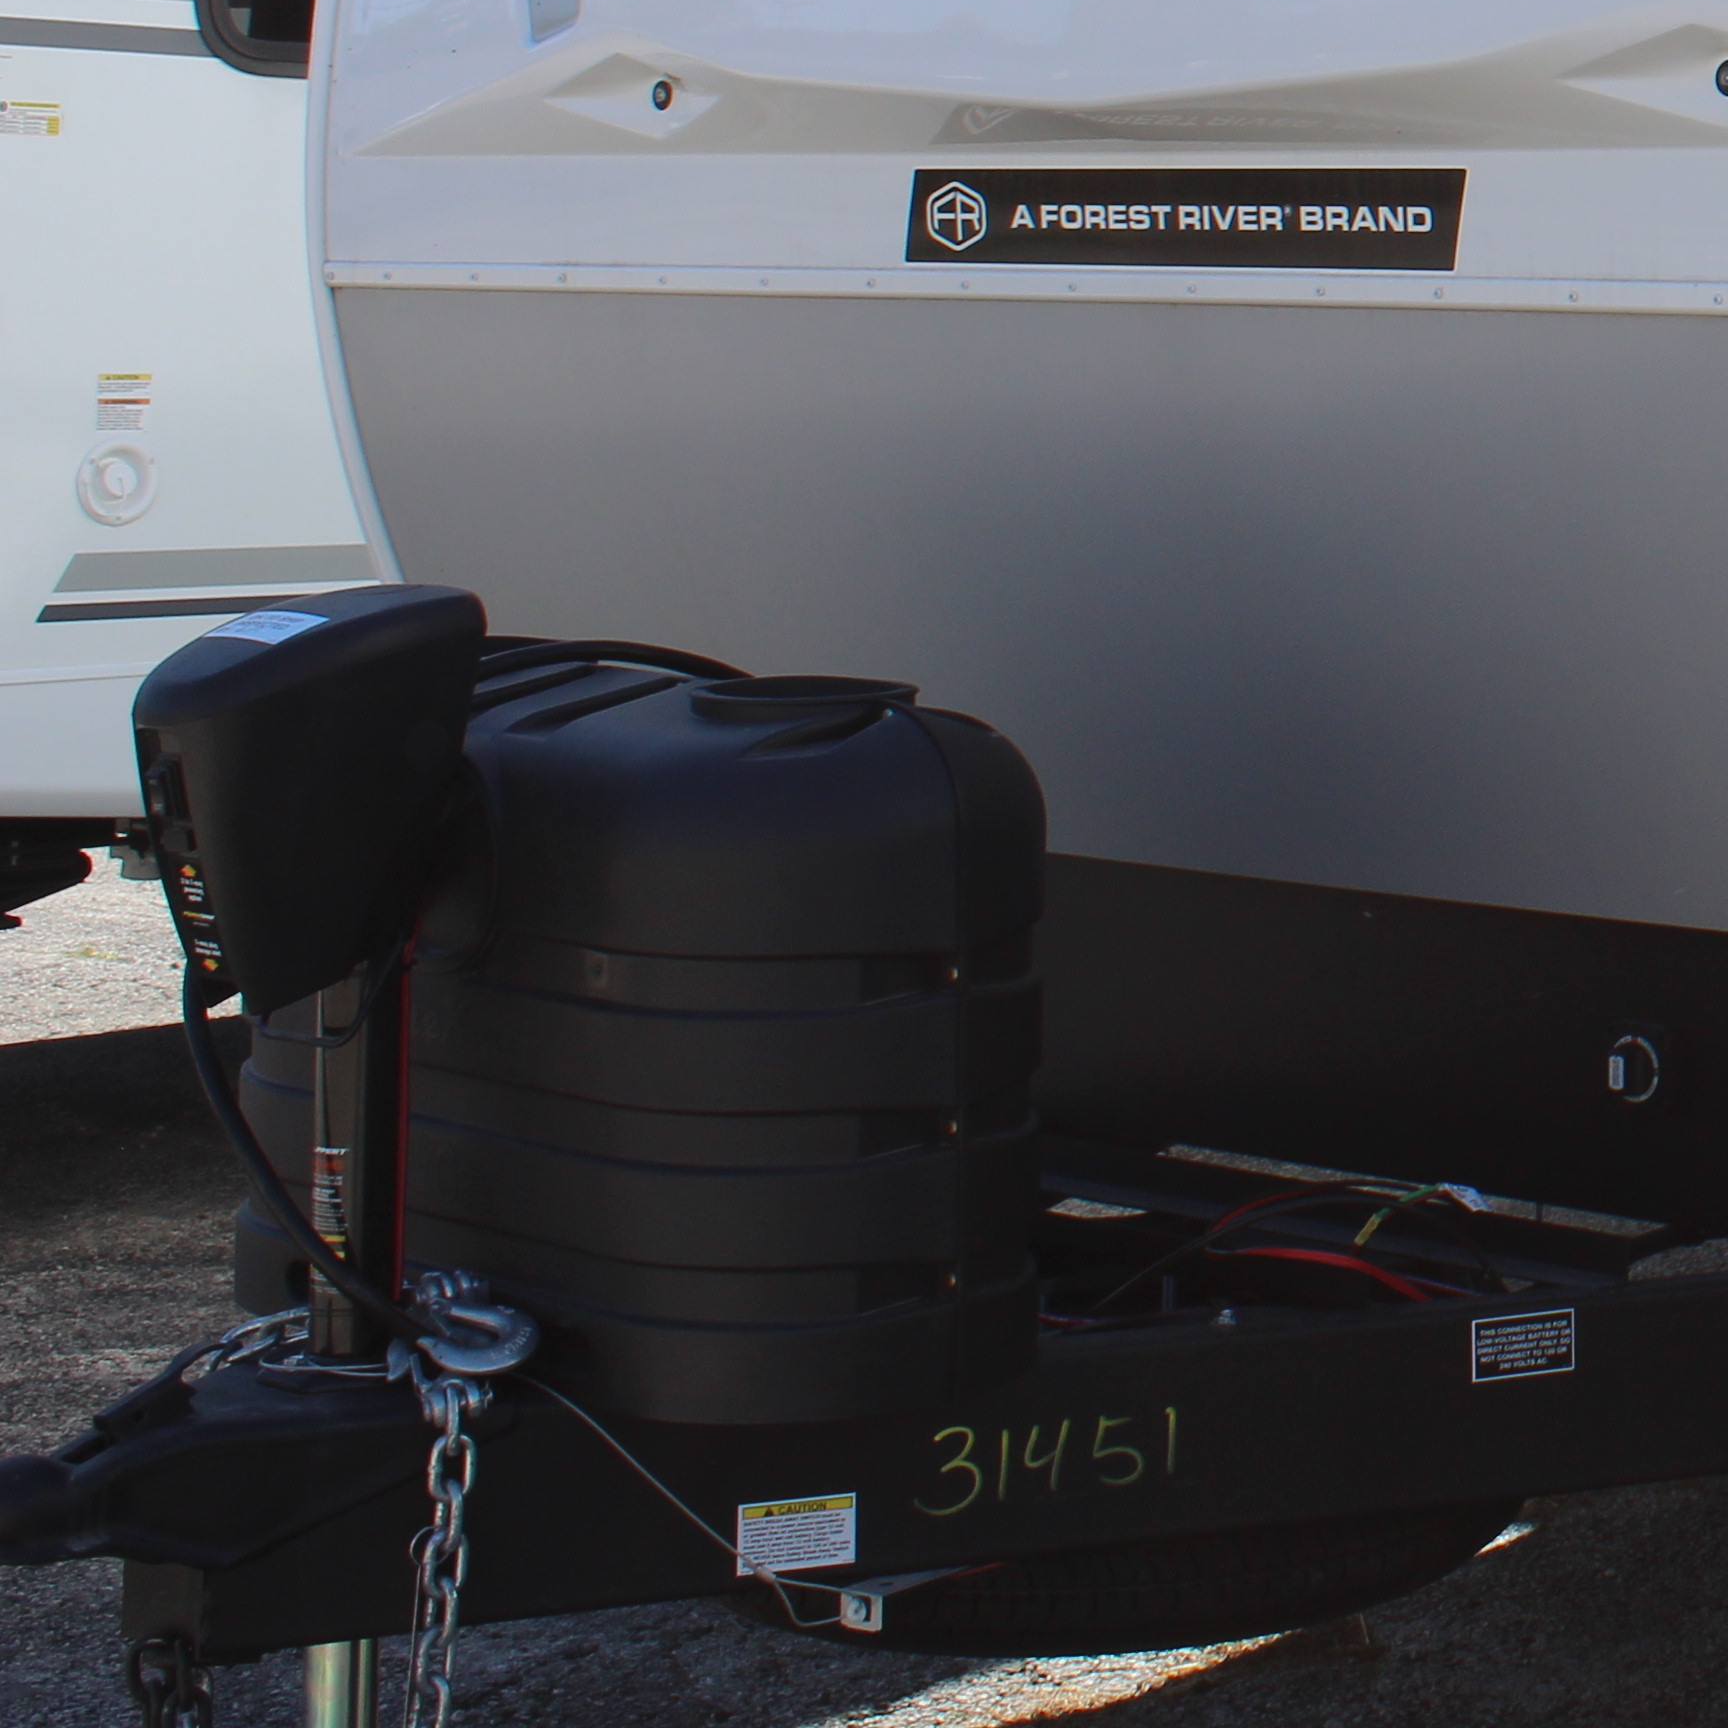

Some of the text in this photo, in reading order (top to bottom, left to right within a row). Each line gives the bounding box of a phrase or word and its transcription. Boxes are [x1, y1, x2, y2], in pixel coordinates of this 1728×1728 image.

[1010, 204, 1036, 230] A
[1040, 204, 1172, 231] FOREST
[1299, 206, 1434, 233] BRAND
[914, 1406, 1176, 1516] 31451
[777, 1503, 827, 1515] CAUTION
